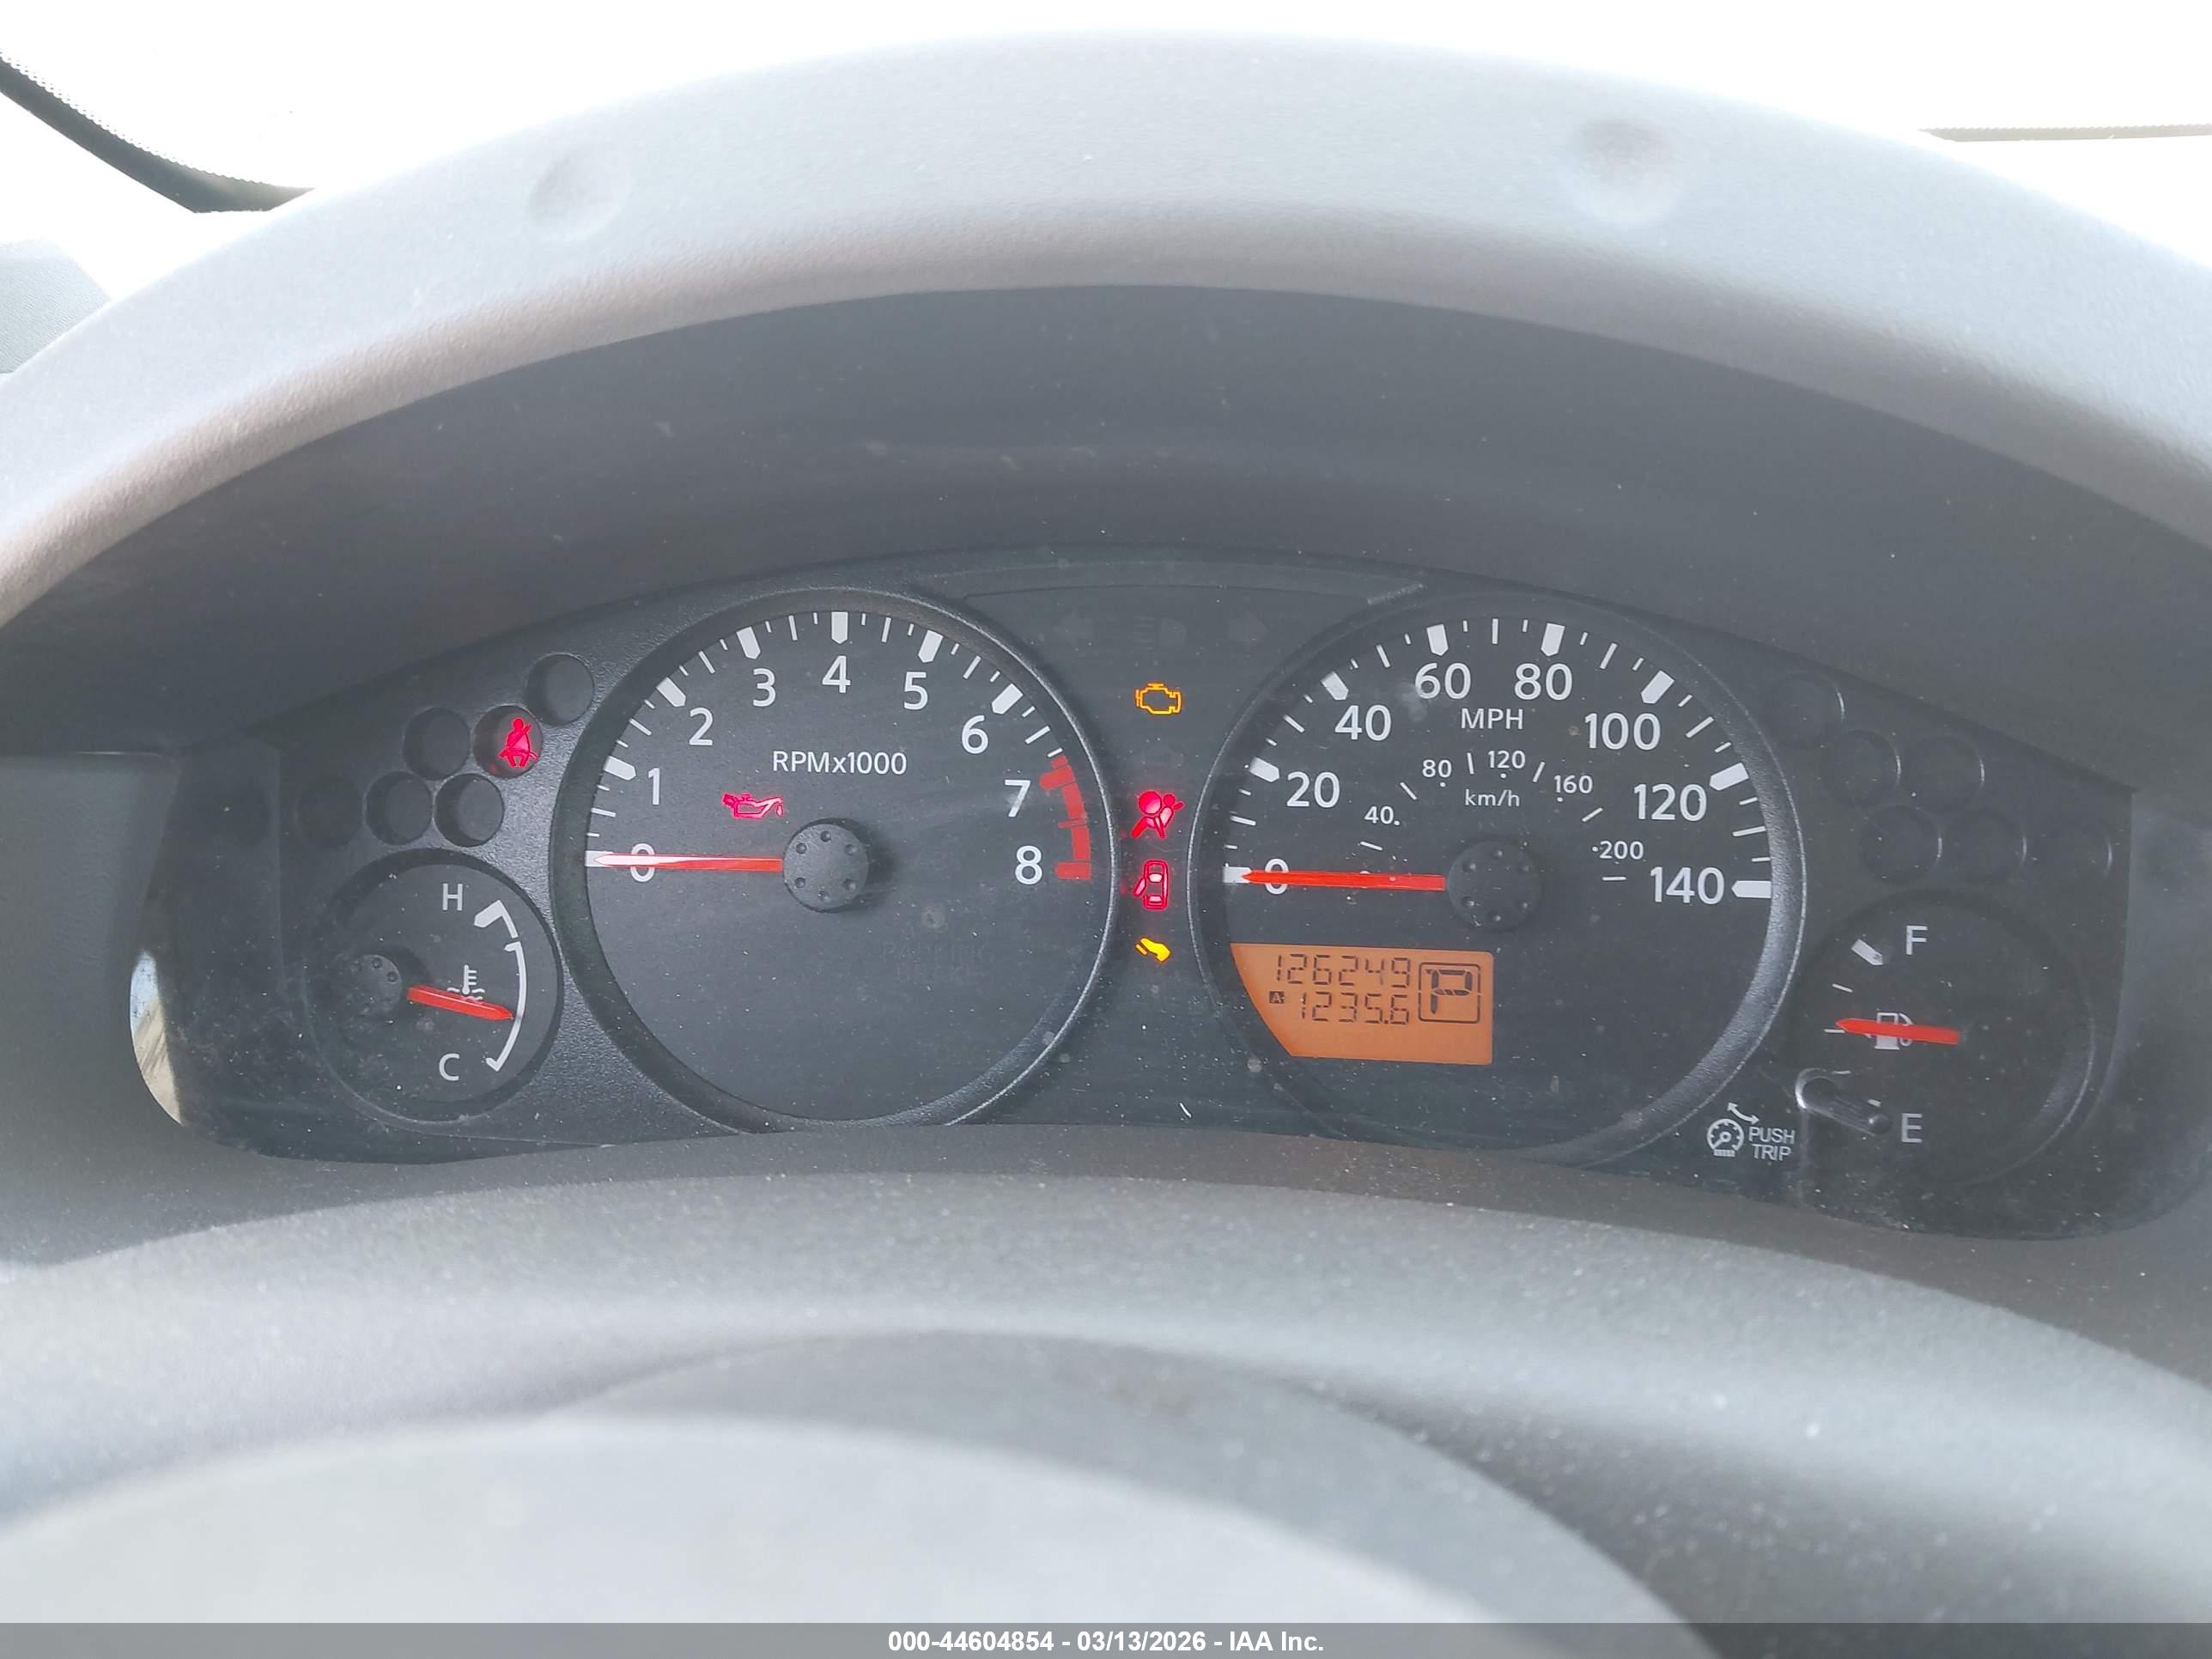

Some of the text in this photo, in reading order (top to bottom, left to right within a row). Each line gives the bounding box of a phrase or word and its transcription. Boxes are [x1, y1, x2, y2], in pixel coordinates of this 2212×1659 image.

[753, 668, 775, 707] 3
[823, 656, 850, 693] 4
[904, 672, 927, 709] 5
[1415, 663, 1470, 699] 60
[1515, 664, 1571, 700] 80
[690, 708, 713, 745] 2
[962, 715, 988, 754] 6
[1335, 705, 1391, 740] 40
[1462, 708, 1522, 729] MPH
[1585, 713, 1660, 750] 100
[774, 751, 906, 774] RPMx1000
[1423, 760, 1451, 777] 80
[1488, 750, 1525, 769] 120
[648, 769, 659, 805] 1
[1006, 780, 1030, 817] 7
[1287, 772, 1340, 807] 20
[1466, 789, 1519, 806] km/h
[1554, 775, 1592, 793] 160
[1364, 806, 1393, 824] 40
[1634, 784, 1706, 821] 120
[630, 843, 656, 882] 0
[1015, 846, 1042, 884] 8
[1600, 841, 1643, 859] 200
[1265, 859, 1288, 894] 0
[1650, 867, 1724, 904] 140
[443, 884, 463, 910] H
[1906, 926, 1927, 955] F
[1276, 953, 1411, 988] 126249
[1301, 991, 1410, 1024] 1235.6
[1425, 969, 1474, 1015] P
[440, 1054, 459, 1080] C
[1749, 1126, 1796, 1145] PUSH
[1902, 1113, 1922, 1142] E
[1753, 1144, 1792, 1160] TRIP
